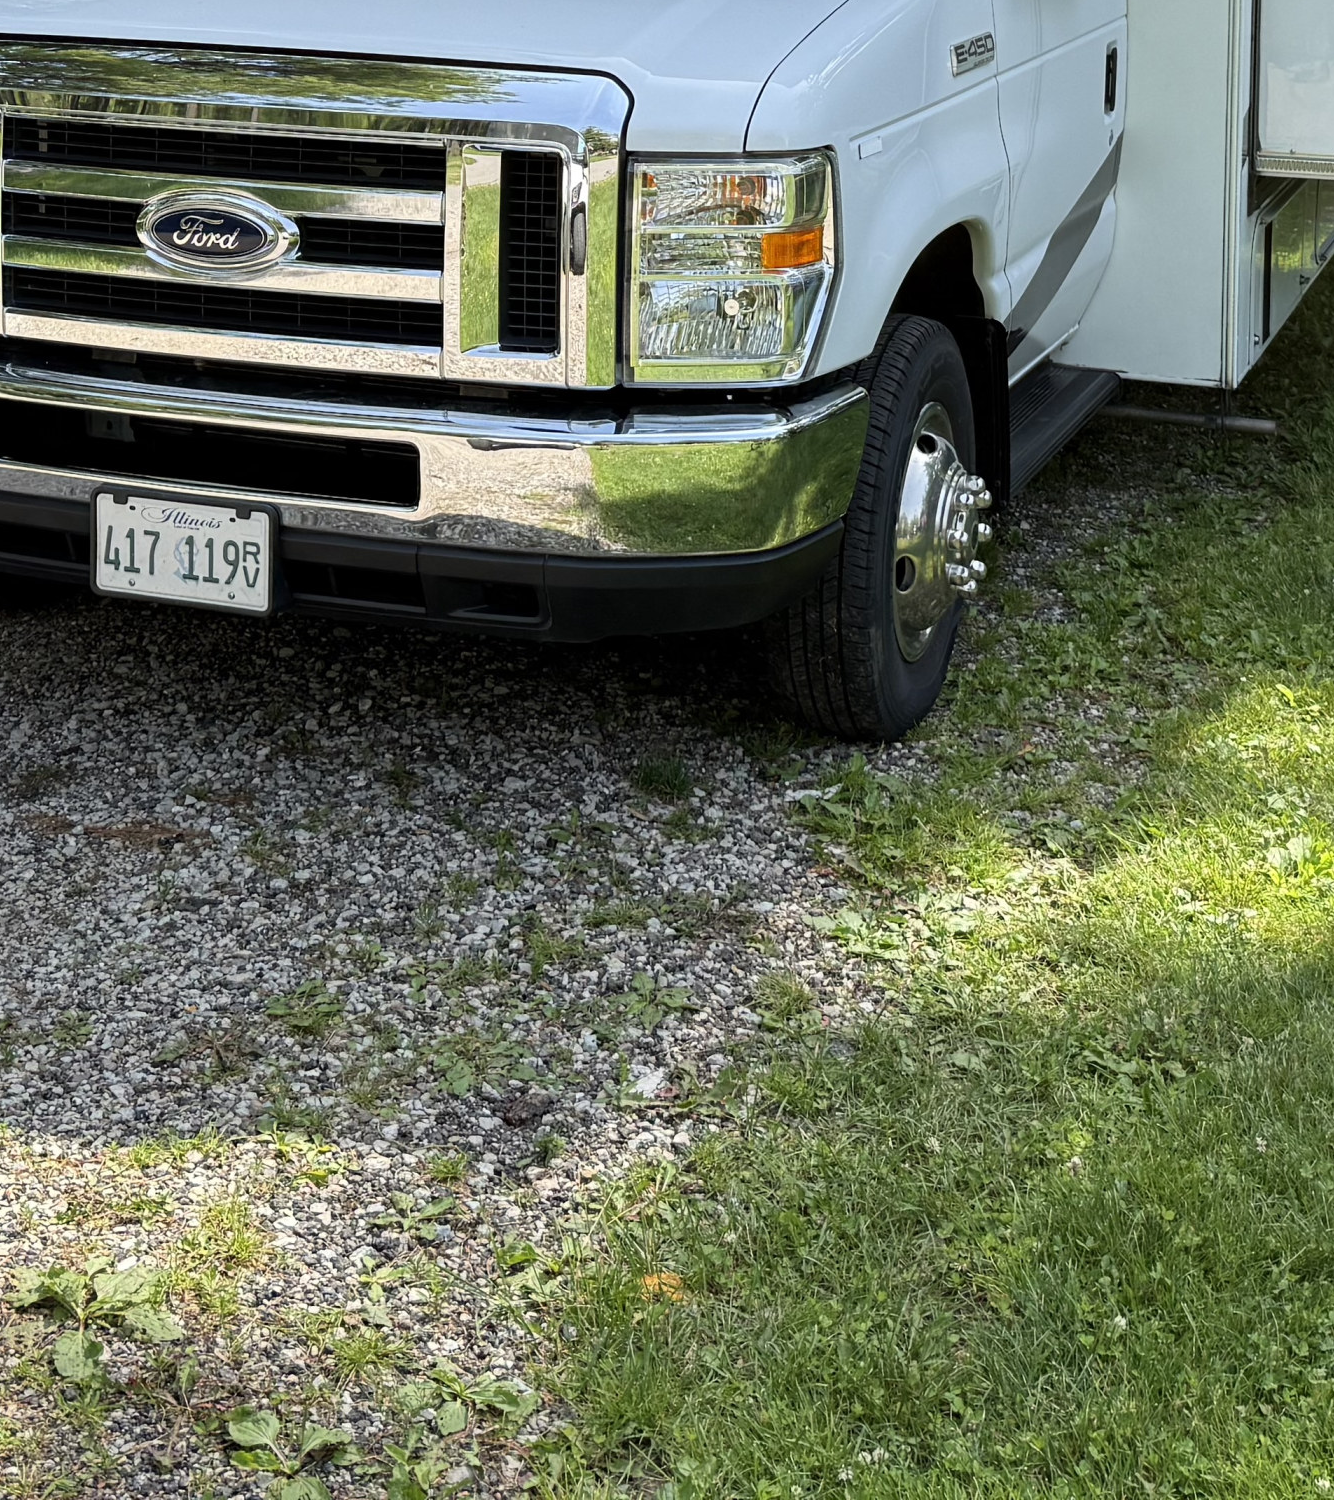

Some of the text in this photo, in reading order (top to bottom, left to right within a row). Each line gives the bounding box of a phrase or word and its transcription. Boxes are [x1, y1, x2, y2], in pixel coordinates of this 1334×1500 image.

[172, 215, 241, 250] Ford
[141, 506, 223, 529] Illinois
[103, 525, 239, 585] 417 119
